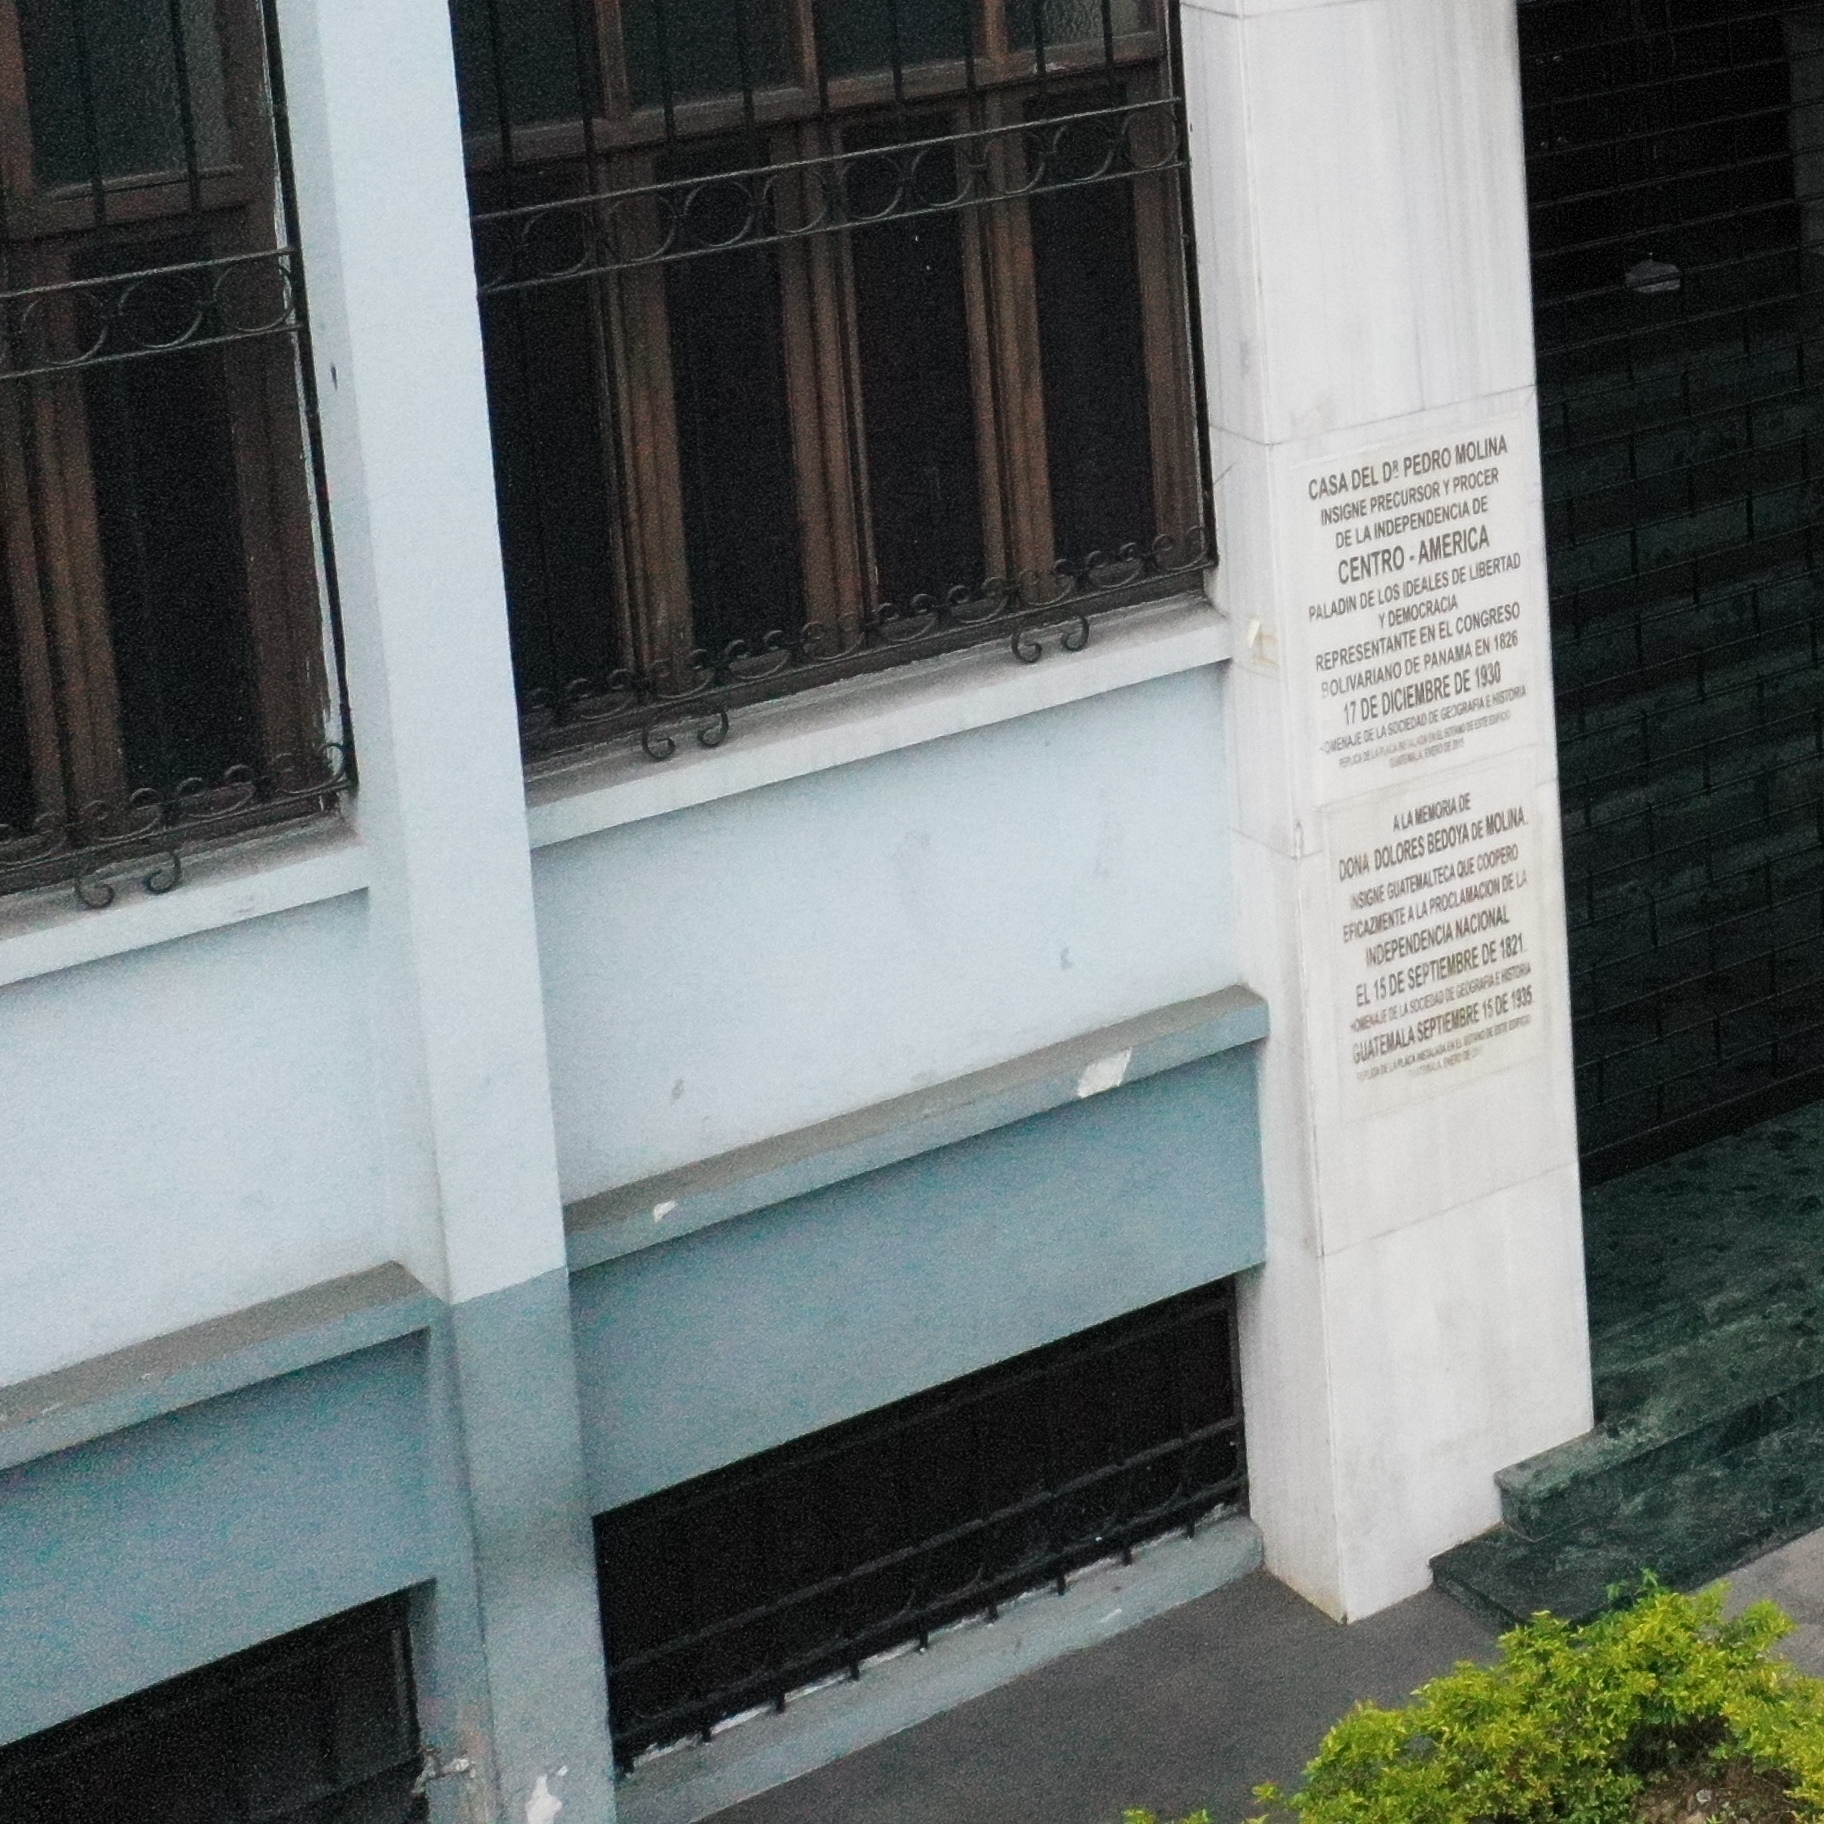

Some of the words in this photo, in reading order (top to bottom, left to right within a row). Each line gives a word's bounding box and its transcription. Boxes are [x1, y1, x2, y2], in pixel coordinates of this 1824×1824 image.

[1309, 473, 1349, 500] CASA
[1352, 465, 1378, 489] DEL
[1404, 447, 1451, 477] PEDRO
[1456, 434, 1507, 465] MOLINA
[1321, 500, 1367, 526] INSIGNE
[1370, 481, 1440, 514] PRECURSOR
[1443, 479, 1450, 495] Y
[1453, 467, 1499, 493] PROCER
[1336, 531, 1351, 549] DE
[1357, 527, 1372, 543] LA
[1374, 502, 1469, 539] INDEPENDENCIA
[1472, 496, 1488, 514] DE
[1338, 545, 1405, 585] CENTRO
[1418, 524, 1490, 565] AMERICA
[1309, 594, 1357, 622] PALADIN
[1360, 591, 1375, 609] DE
[1378, 584, 1400, 605] LOS
[1403, 572, 1449, 599] IDEALES
[1452, 567, 1466, 584] DE
[1469, 552, 1521, 580] LIBERTAD
[1378, 614, 1385, 629] Y
[1388, 594, 1458, 628] DEMOCRACIA
[1316, 631, 1417, 672] REPRESENTANTE
[1420, 626, 1436, 644] EN
[1439, 622, 1453, 638] EL
[1456, 601, 1520, 634] CONGRESO
[1321, 661, 1401, 698] BOLIVARIANO
[1405, 657, 1421, 675] DE
[1424, 643, 1472, 671] PANAMA
[1475, 637, 1490, 656] EN
[1494, 630, 1518, 652] 1826
[1344, 701, 1357, 725] 17
[1361, 695, 1378, 721] DE
[1382, 678, 1451, 713] DICIEMBRE
[1455, 670, 1472, 695] DE
[1475, 661, 1501, 687] 1930
[1320, 731, 1361, 754] OMENAJE
[1393, 815, 1399, 832] A
[1401, 813, 1413, 828] LA
[1415, 797, 1456, 826] MEMORIA
[1459, 793, 1470, 812] DE
[1375, 837, 1424, 870] DOLORES
[1428, 822, 1469, 855] BEDOYA
[1472, 820, 1483, 839] DE
[1387, 866, 1455, 900] GUATEMALTECA
[1457, 857, 1474, 879] QUE
[1477, 844, 1518, 872] COOPERO
[1343, 906, 1405, 944] EFICAZMENTE
[1408, 904, 1413, 920] A
[1416, 902, 1428, 920] LA
[1430, 878, 1500, 914] PROCLAMACION
[1503, 876, 1513, 890] DE
[1516, 869, 1527, 888] LA
[1366, 922, 1453, 968] INDEPENDENCIA
[1455, 902, 1509, 940] NACIONAL
[1356, 983, 1370, 1007] EL
[1374, 976, 1386, 1000] 15
[1389, 973, 1405, 997] DE
[1407, 947, 1479, 990] SEPTIEMBRE
[1481, 940, 1497, 965] DE
[1350, 1009, 1386, 1032] OMENAJE
[1352, 1025, 1415, 1064] GUATEMALA
[1416, 1002, 1480, 1043] SEPTIEMBRE
[1482, 998, 1493, 1018] 15
[1495, 993, 1508, 1016] DE
[1511, 984, 1532, 1010] 1935
